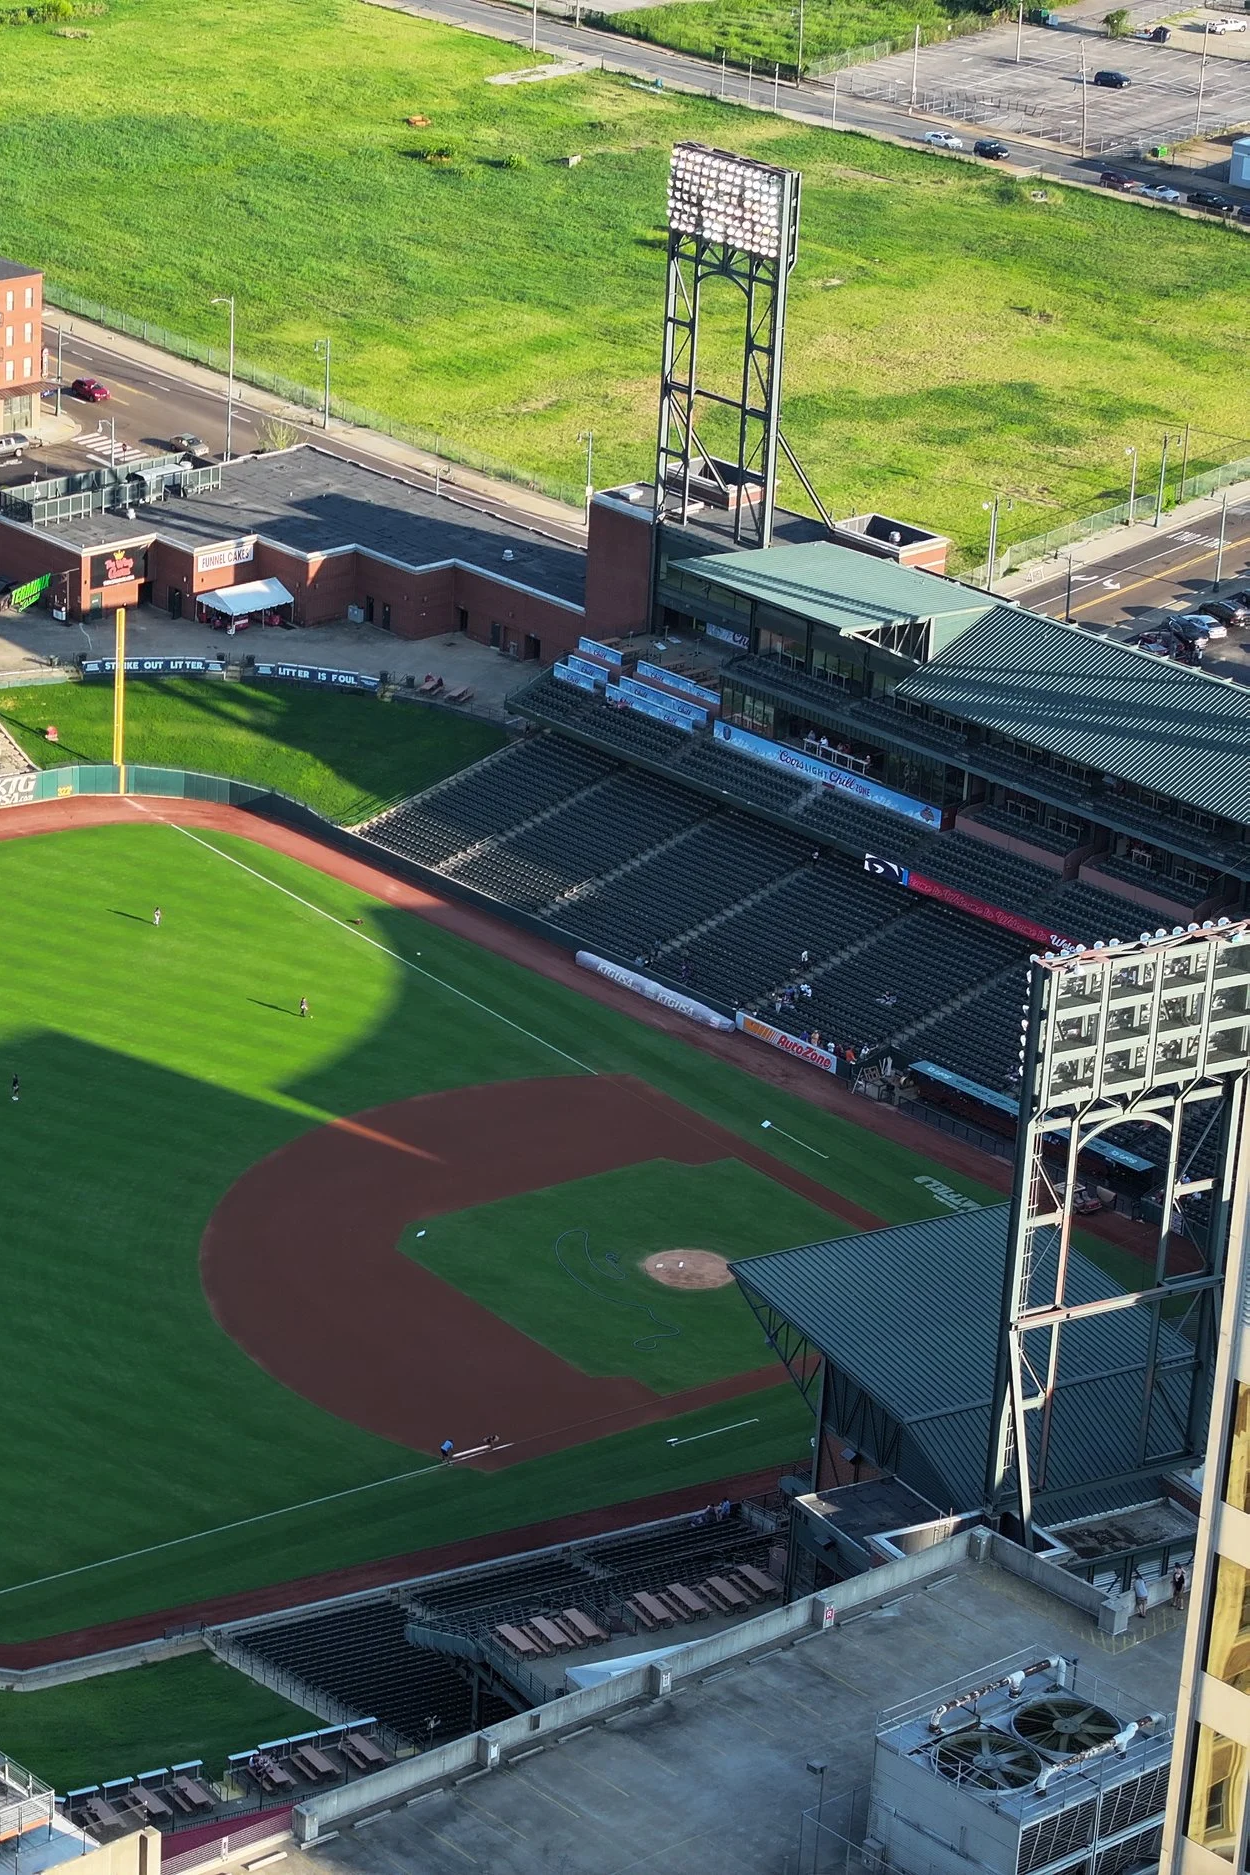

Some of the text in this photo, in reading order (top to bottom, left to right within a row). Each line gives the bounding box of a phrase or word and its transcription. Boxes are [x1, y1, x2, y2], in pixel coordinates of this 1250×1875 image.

[202, 548, 249, 568] FUNNEL CAKES
[11, 572, 51, 606] TERMINIX
[105, 661, 139, 670] STIKE
[144, 661, 164, 670] OUT
[278, 667, 310, 678] LITTER
[318, 672, 327, 680] IS
[779, 749, 870, 797] Coors LIGHT Chill ZONE
[1050, 935, 1078, 952] Welc
[777, 1034, 832, 1069] AutoZone
